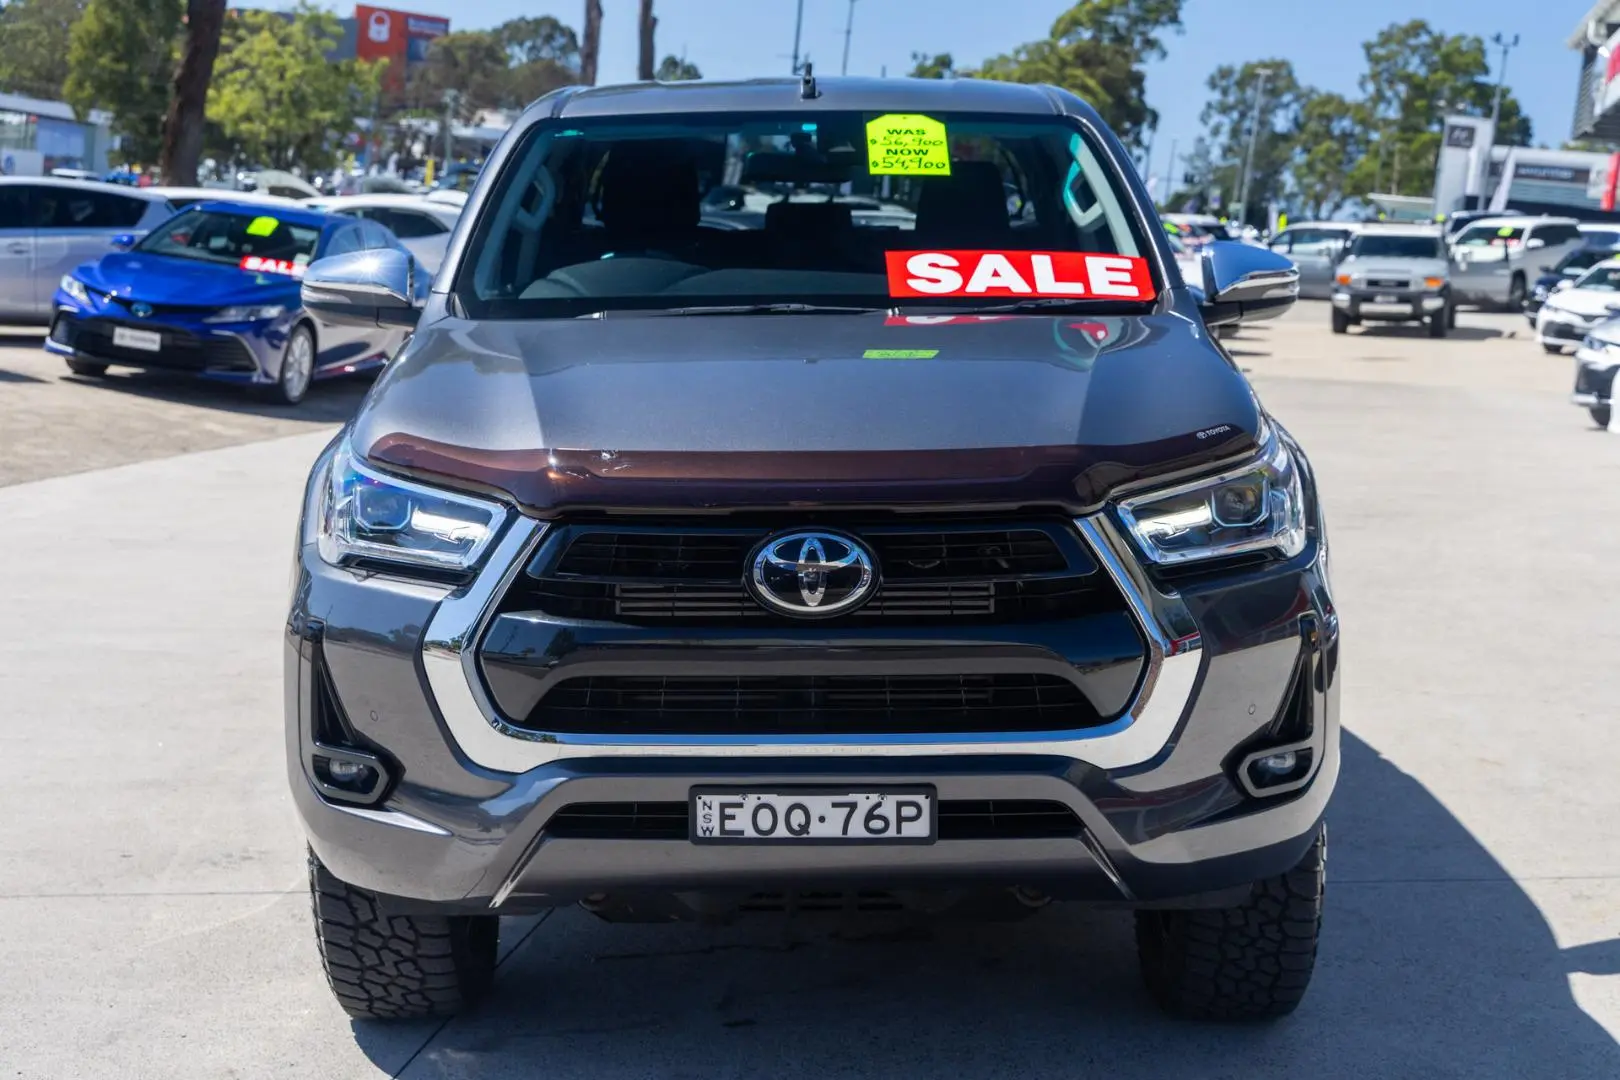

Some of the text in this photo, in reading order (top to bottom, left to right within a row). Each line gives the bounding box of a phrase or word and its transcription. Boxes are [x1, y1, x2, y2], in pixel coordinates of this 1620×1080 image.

[886, 148, 929, 156] NOW
[906, 252, 1140, 297] SALE
[1205, 425, 1231, 436] TOYOTA
